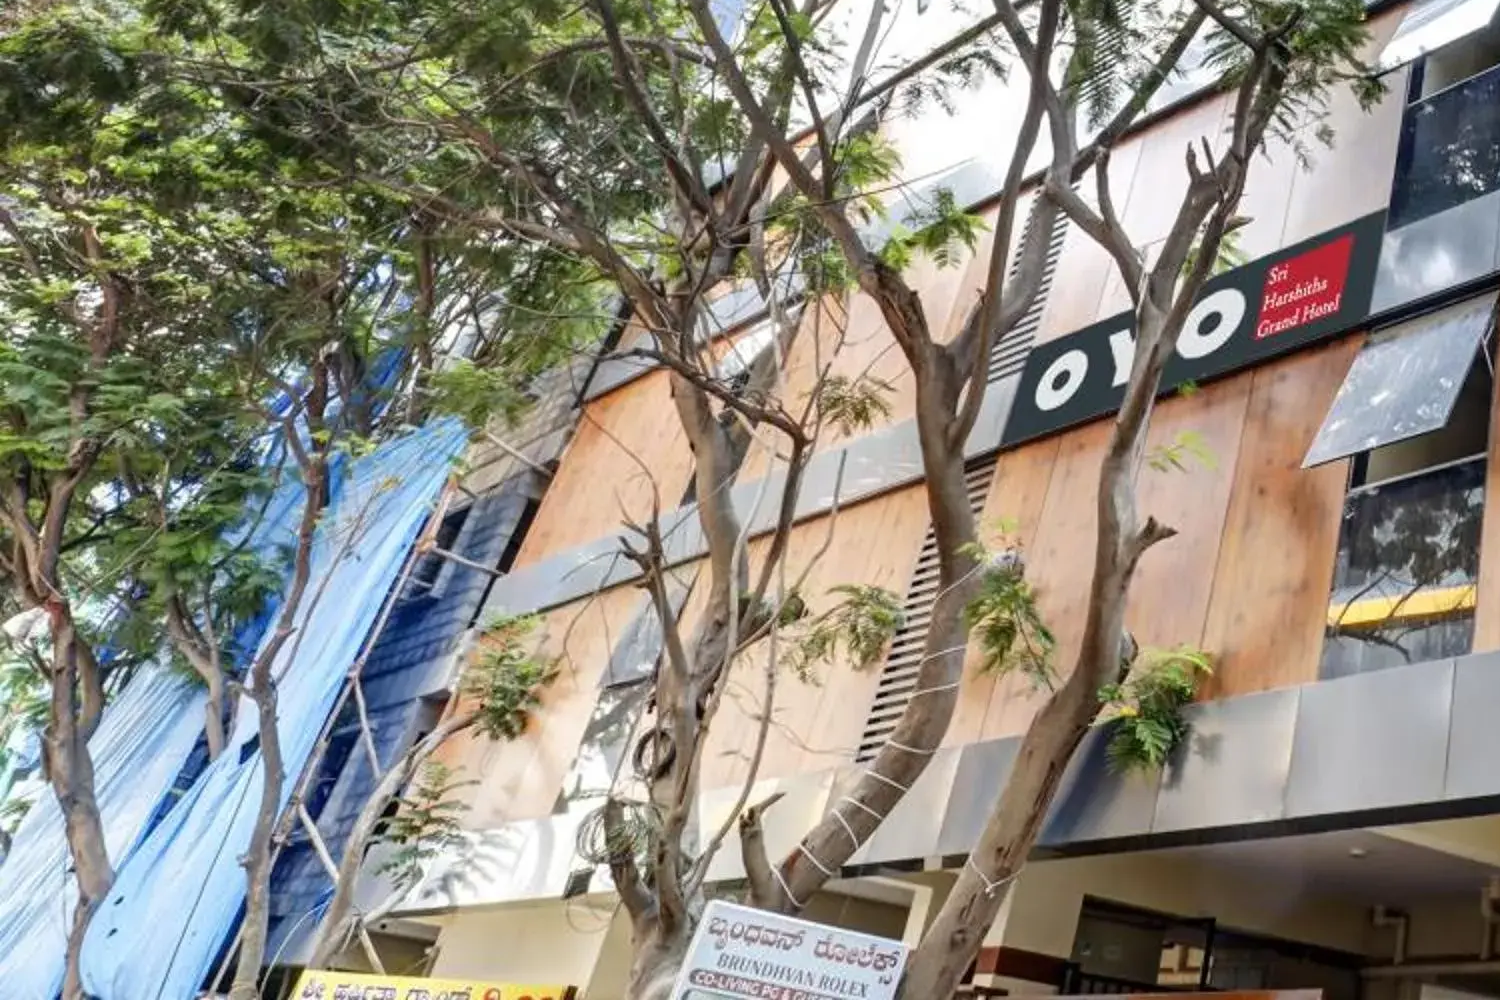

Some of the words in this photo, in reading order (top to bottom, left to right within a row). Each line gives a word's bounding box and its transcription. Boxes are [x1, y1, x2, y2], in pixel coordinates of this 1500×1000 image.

[1267, 264, 1289, 285] Sri
[1257, 308, 1301, 339] Grand
[1302, 293, 1342, 324] Hotel
[695, 971, 759, 995] CO-LIVING
[717, 953, 815, 986] BRUNDHVAN
[818, 974, 871, 998] ROLEX
